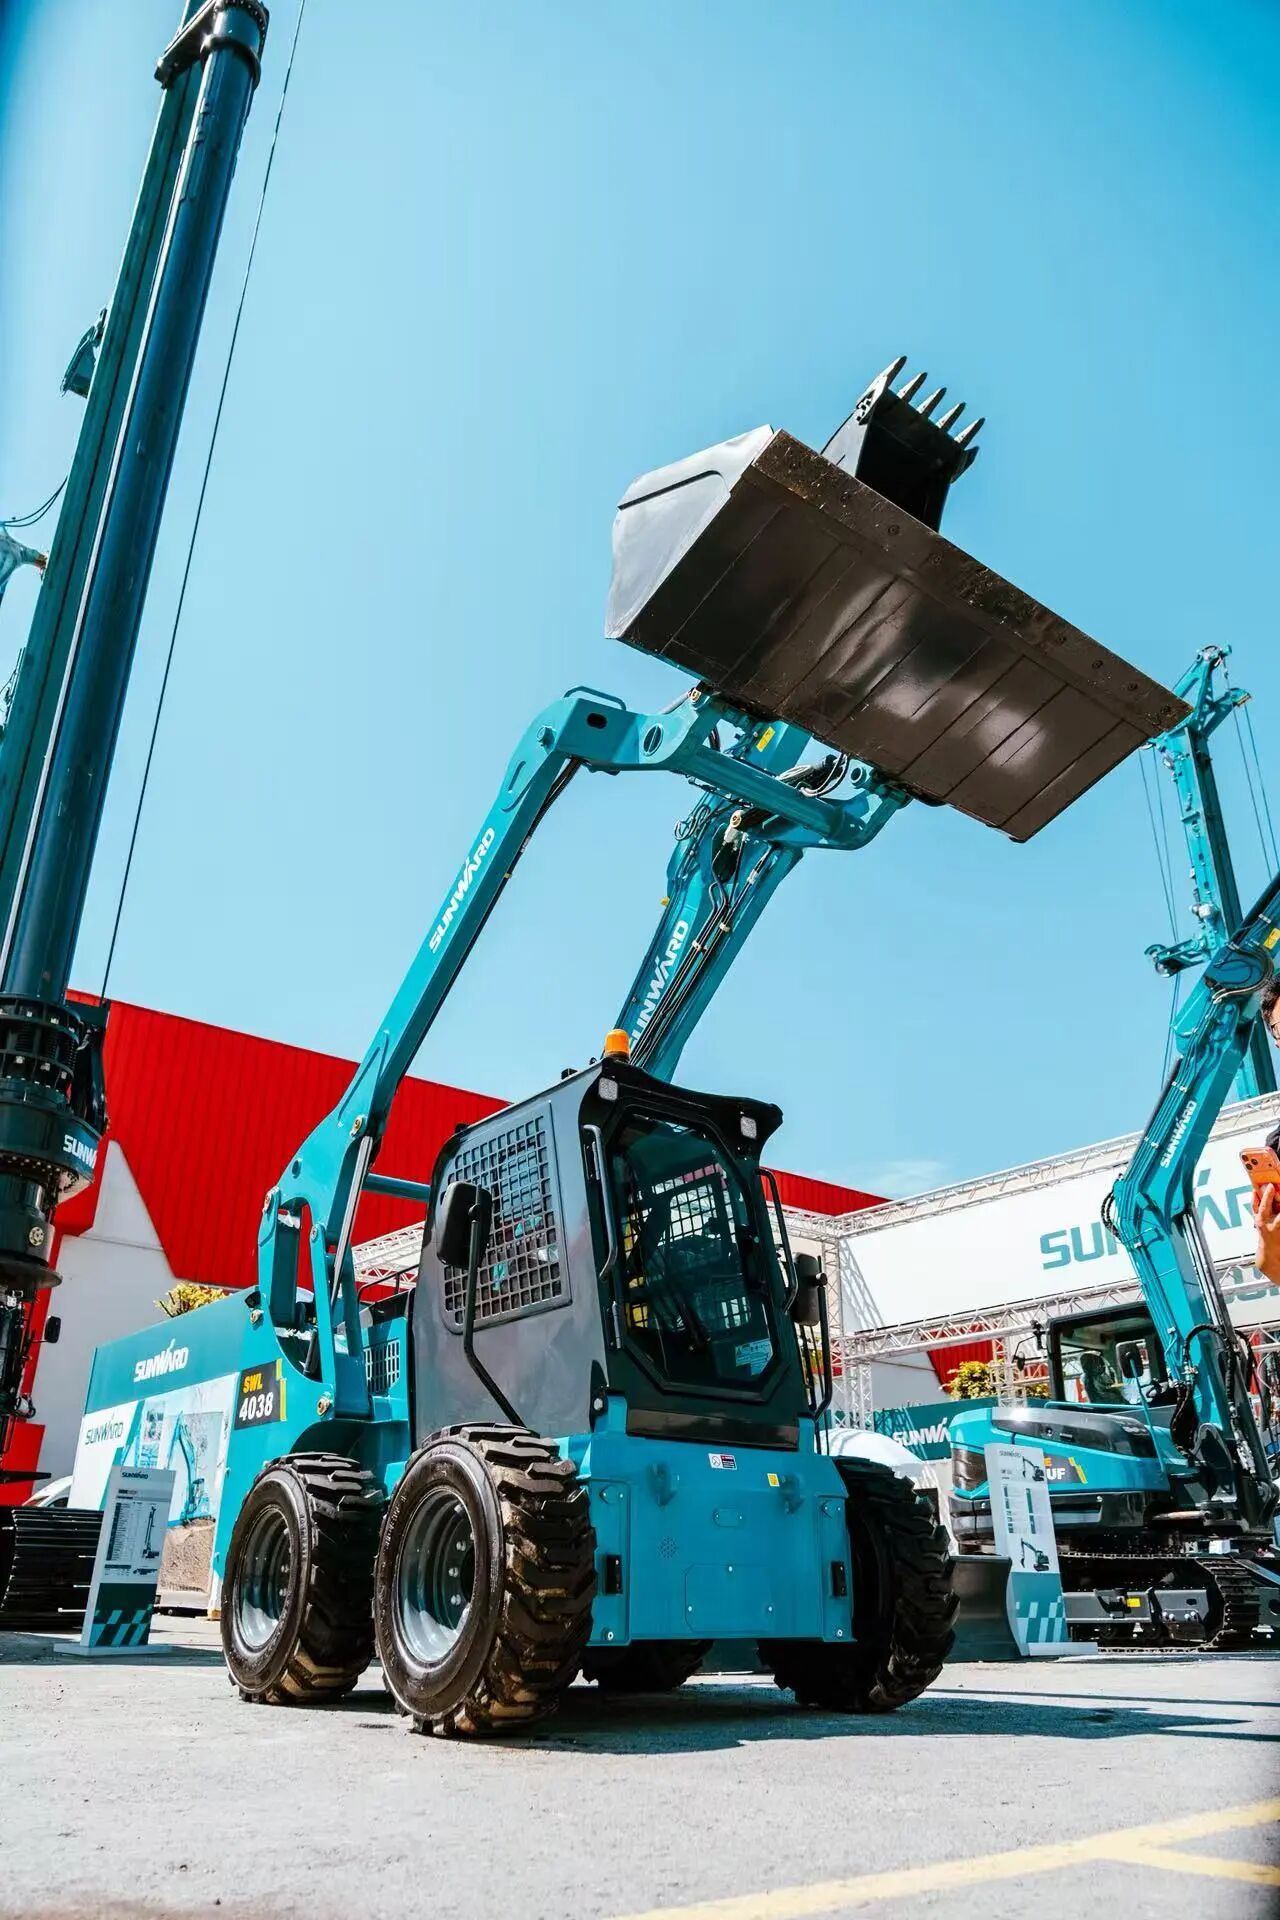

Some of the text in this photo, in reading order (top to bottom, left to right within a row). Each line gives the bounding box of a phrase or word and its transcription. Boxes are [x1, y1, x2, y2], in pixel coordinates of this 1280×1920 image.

[429, 827, 495, 954] SUNWARD
[630, 919, 689, 1051] UNWARD
[1160, 1100, 1197, 1169] SUNWARD
[134, 1338, 190, 1383] SUNWARD
[243, 1373, 263, 1393] SWL
[239, 1391, 274, 1421] 4038
